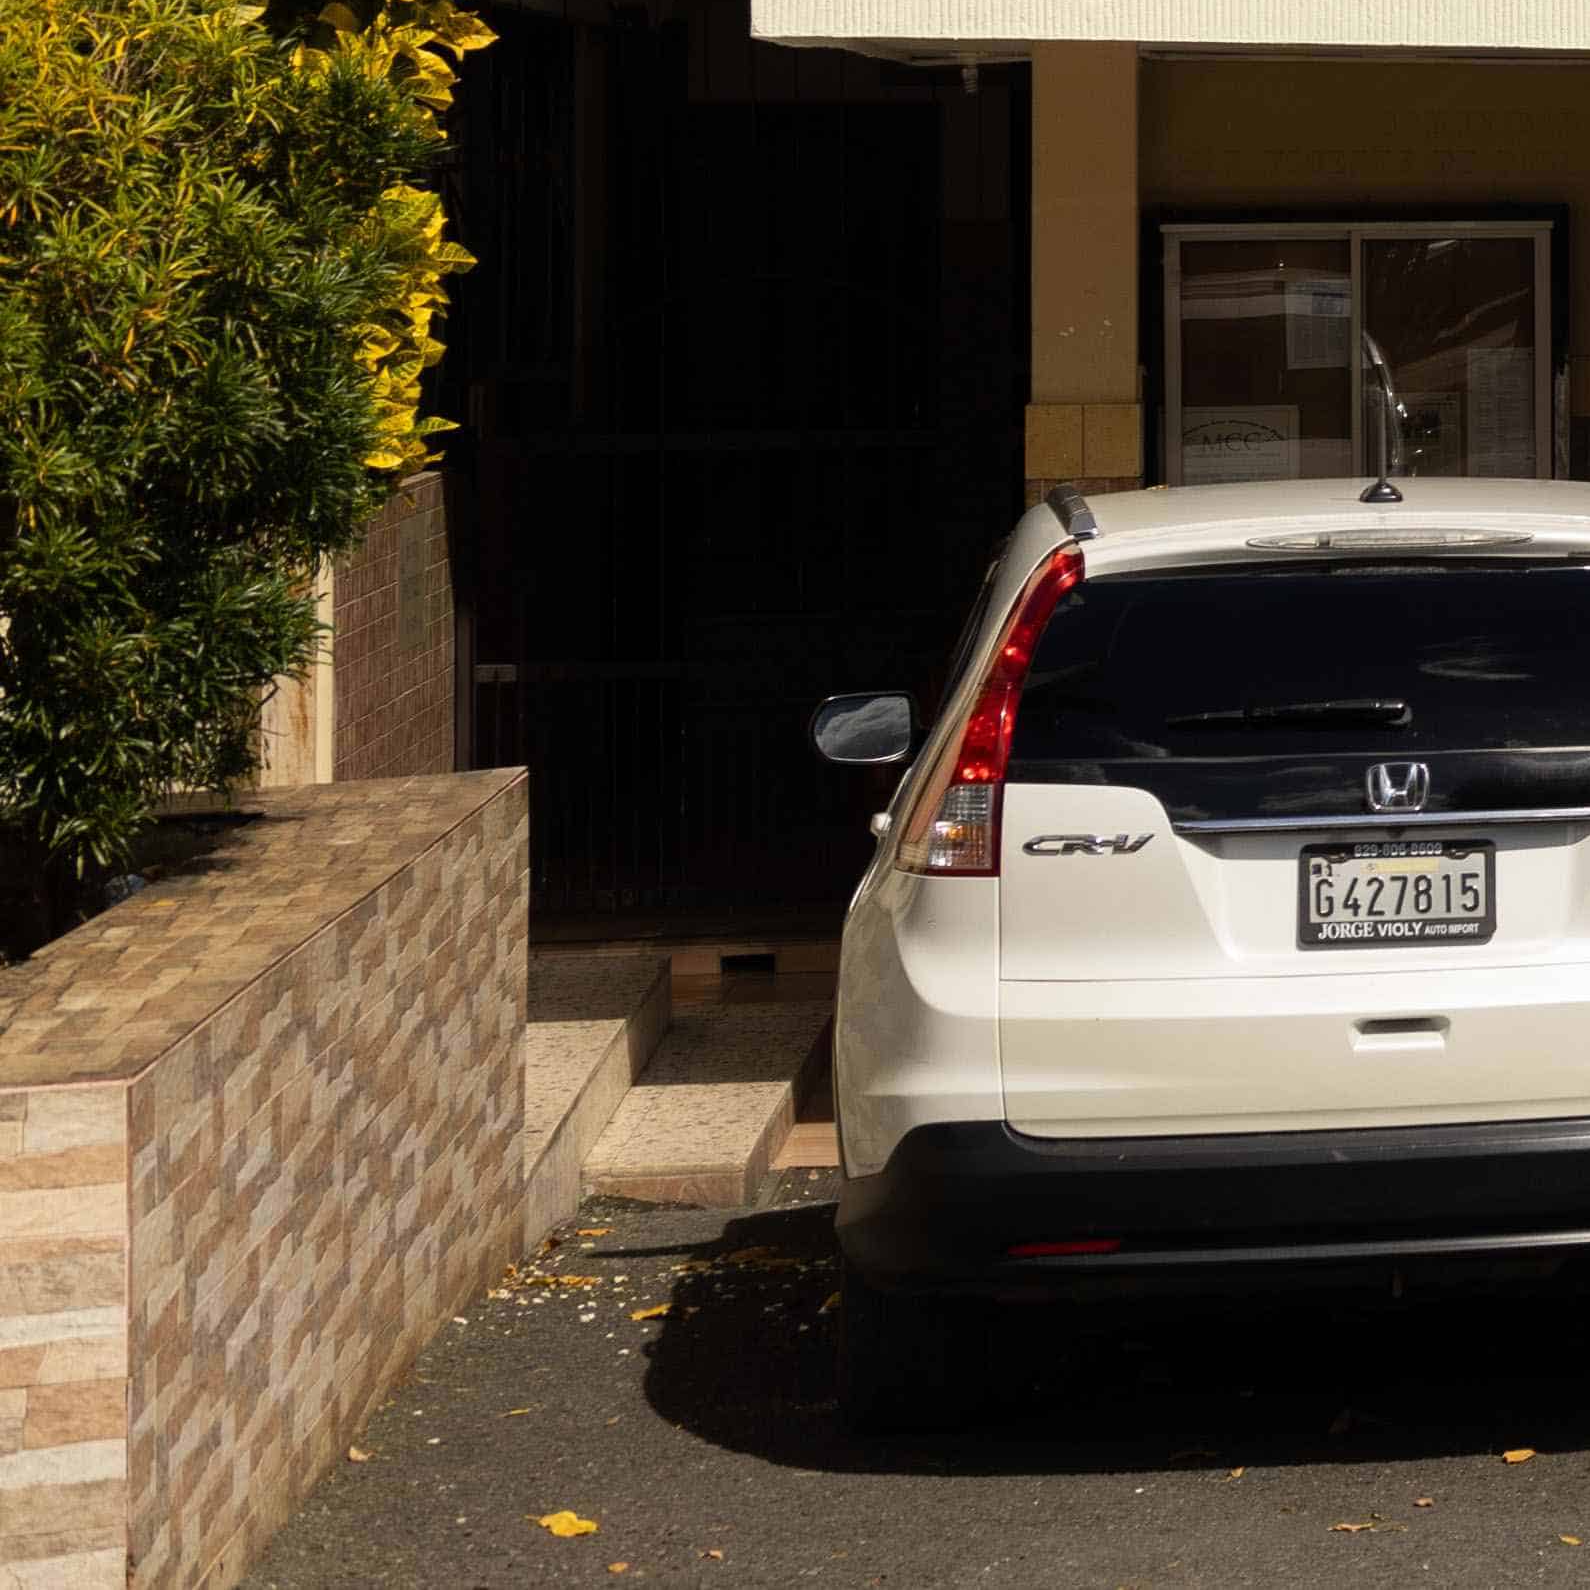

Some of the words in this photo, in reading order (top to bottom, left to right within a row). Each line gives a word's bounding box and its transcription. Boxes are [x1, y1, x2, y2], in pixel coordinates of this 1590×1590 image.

[1022, 834, 1155, 856] CR-V
[1315, 873, 1480, 917] G427815
[1318, 921, 1374, 939] JORGE
[1377, 921, 1423, 937] VIOLY
[1424, 924, 1447, 934] AUTO
[1448, 922, 1479, 934] IMPORT
